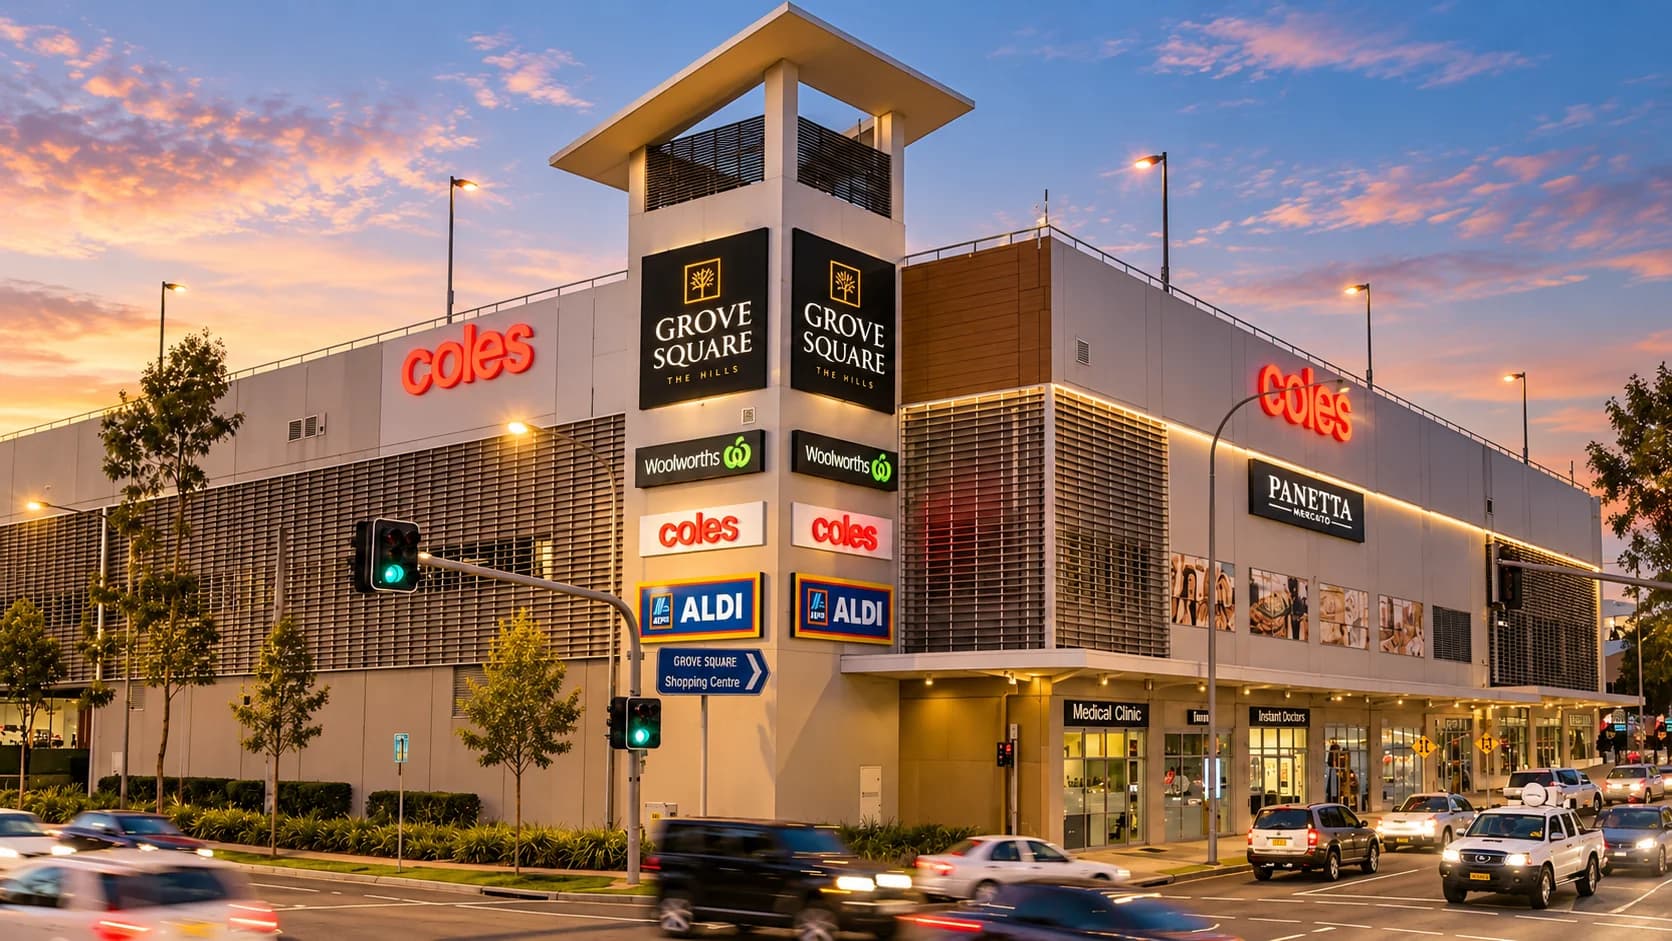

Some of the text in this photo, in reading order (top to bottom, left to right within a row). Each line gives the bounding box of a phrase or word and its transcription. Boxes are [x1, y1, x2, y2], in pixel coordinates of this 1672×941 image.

[655, 300, 753, 342] GROVE
[804, 302, 885, 349] GROVE
[402, 322, 535, 396] coles
[653, 330, 753, 370] SQUARE
[803, 331, 886, 375] SQUARE
[667, 365, 739, 385] THE HILLS
[816, 366, 874, 390] THE HILLS
[1258, 363, 1353, 442] coles
[645, 449, 720, 476] Woolworths
[805, 444, 870, 474] Woolworths
[1268, 474, 1353, 522] PANETTA
[659, 512, 739, 547] coles
[812, 514, 878, 551] coles
[680, 592, 743, 623] ALDI
[833, 596, 882, 627] ALDI
[673, 655, 737, 669] GROVE SQUARE
[665, 675, 740, 691] Shopping Centre
[1073, 703, 1142, 721] Medical Clinic
[1258, 709, 1306, 722] Instant Doctors
